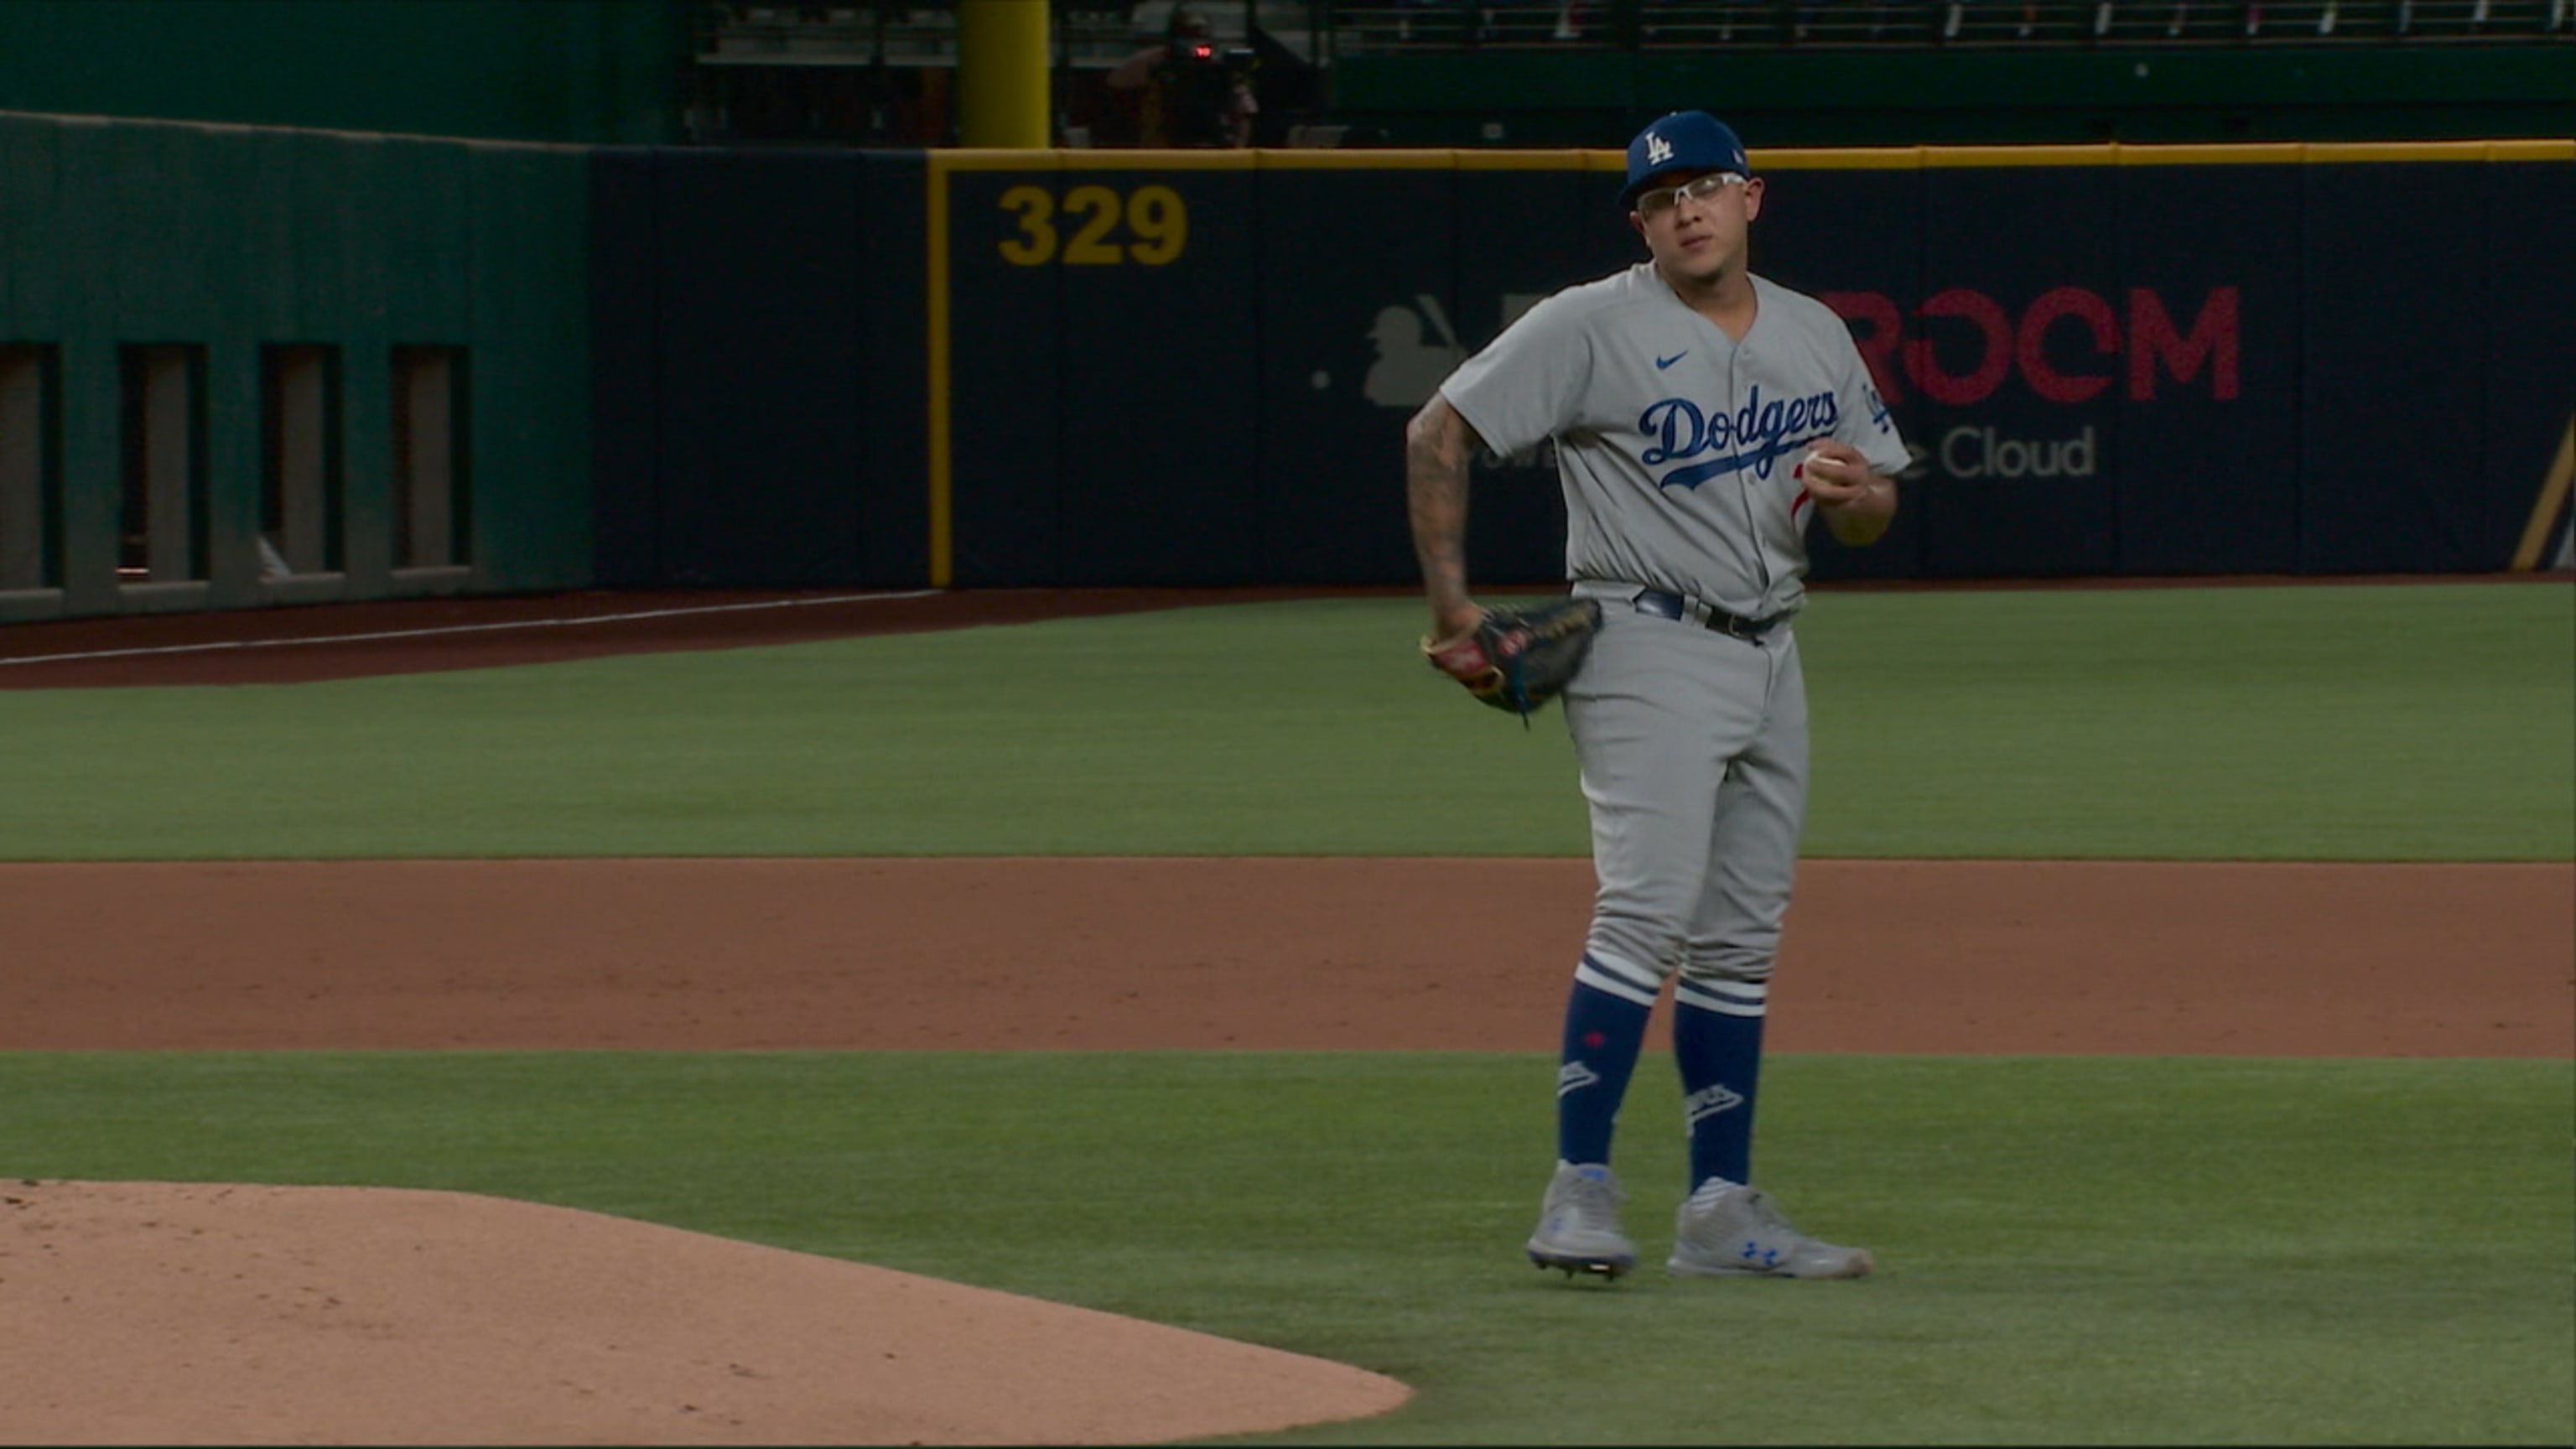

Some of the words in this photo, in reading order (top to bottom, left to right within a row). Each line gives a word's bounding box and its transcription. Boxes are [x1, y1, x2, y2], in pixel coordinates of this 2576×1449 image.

[1645, 131, 1675, 166] LA
[997, 184, 1189, 266] 329
[1821, 286, 2240, 404] ROOM
[1639, 385, 1838, 479] Dodgers
[1940, 425, 2094, 479] Cloud
